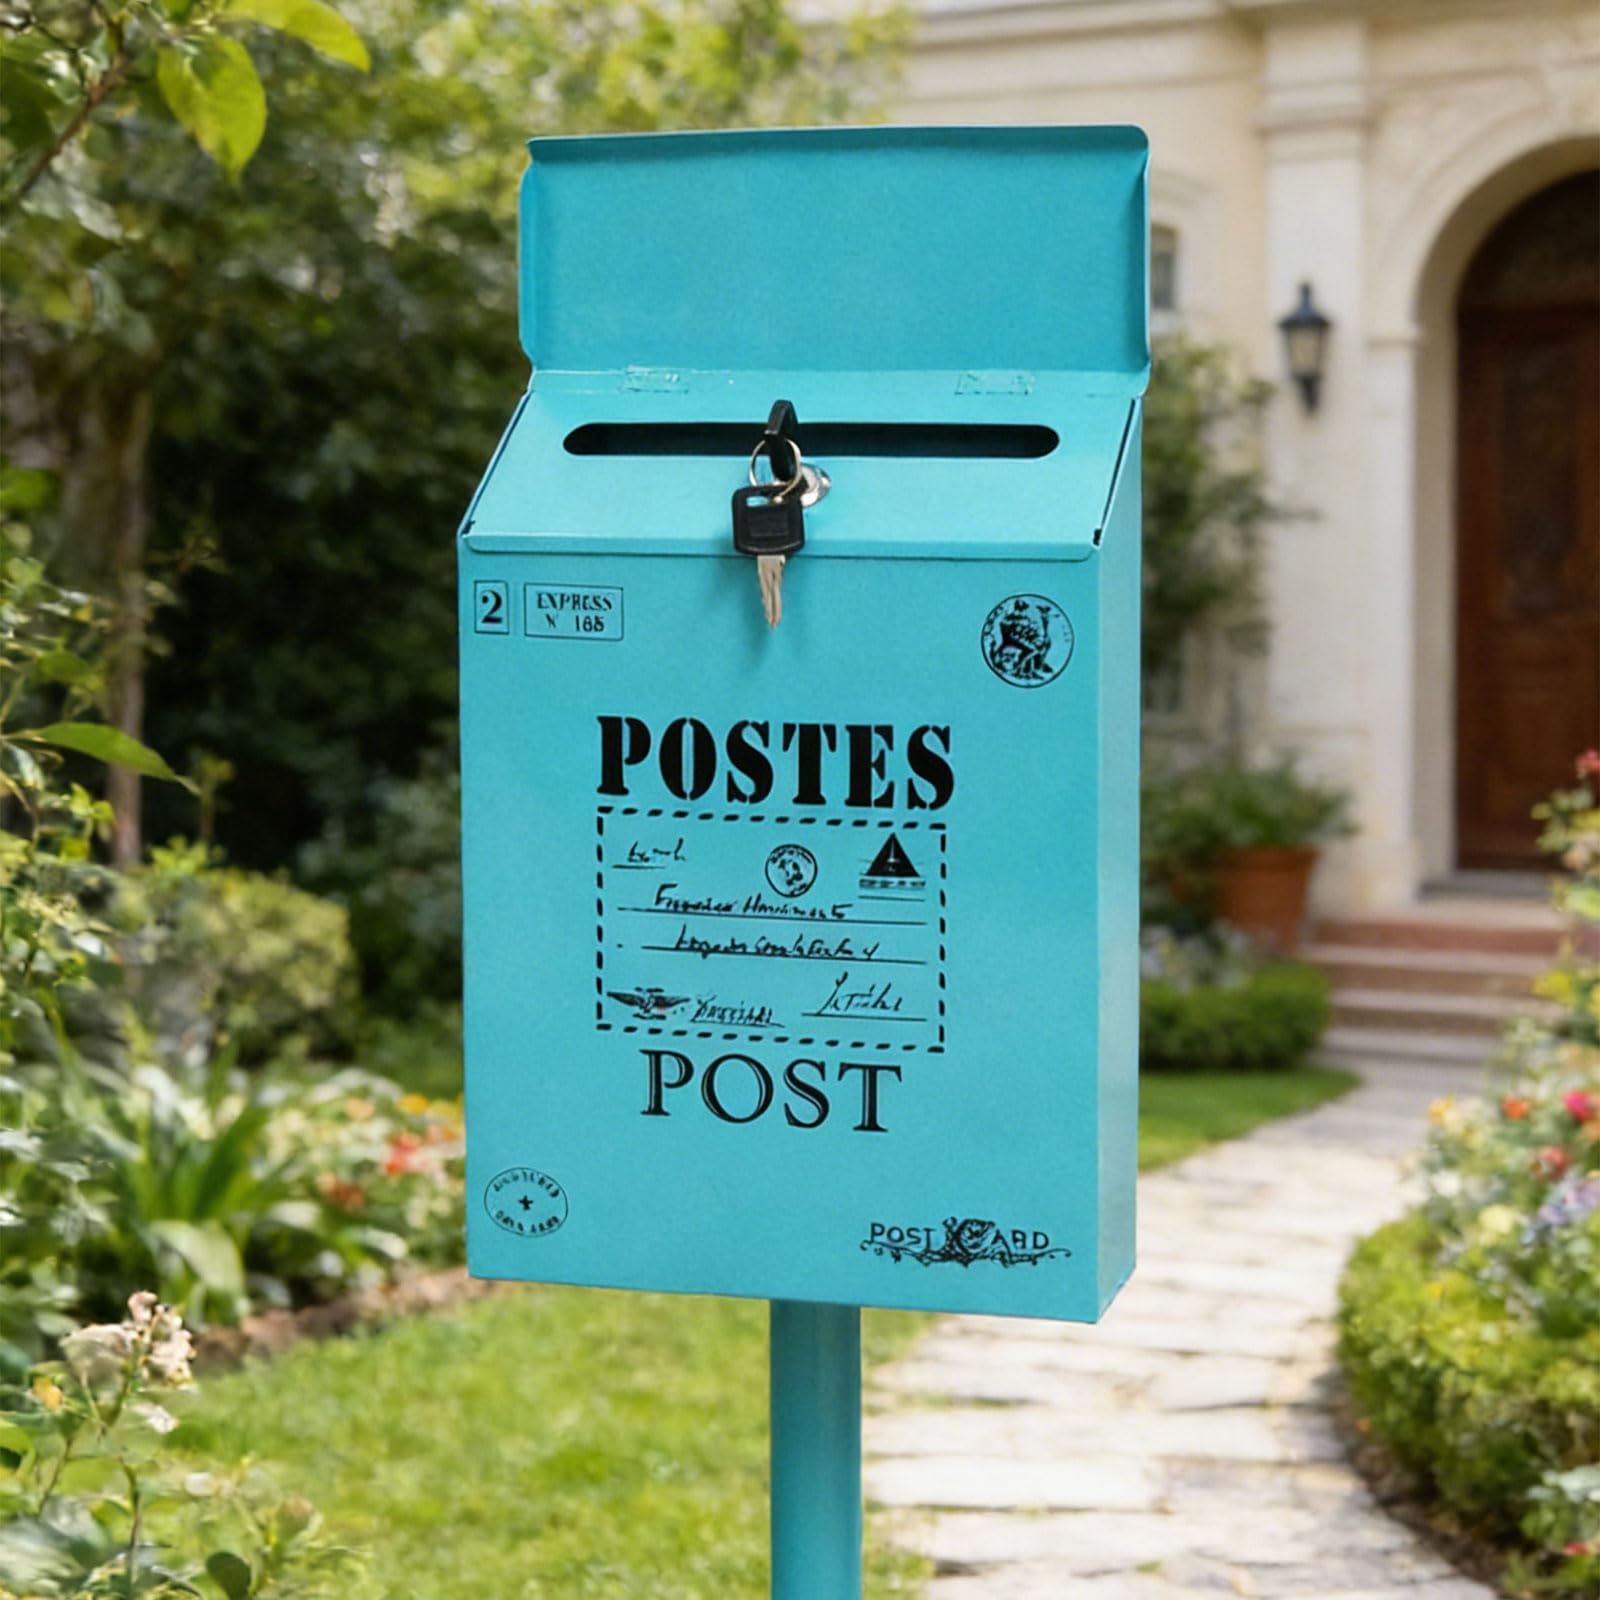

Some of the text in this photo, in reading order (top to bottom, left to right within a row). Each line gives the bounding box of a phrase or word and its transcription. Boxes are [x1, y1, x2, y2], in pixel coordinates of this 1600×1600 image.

[481, 590, 502, 623] 2
[537, 591, 613, 612] EXPRESS
[597, 715, 954, 810] POSTES
[640, 1050, 903, 1132] POST
[870, 1223, 937, 1251] POST
